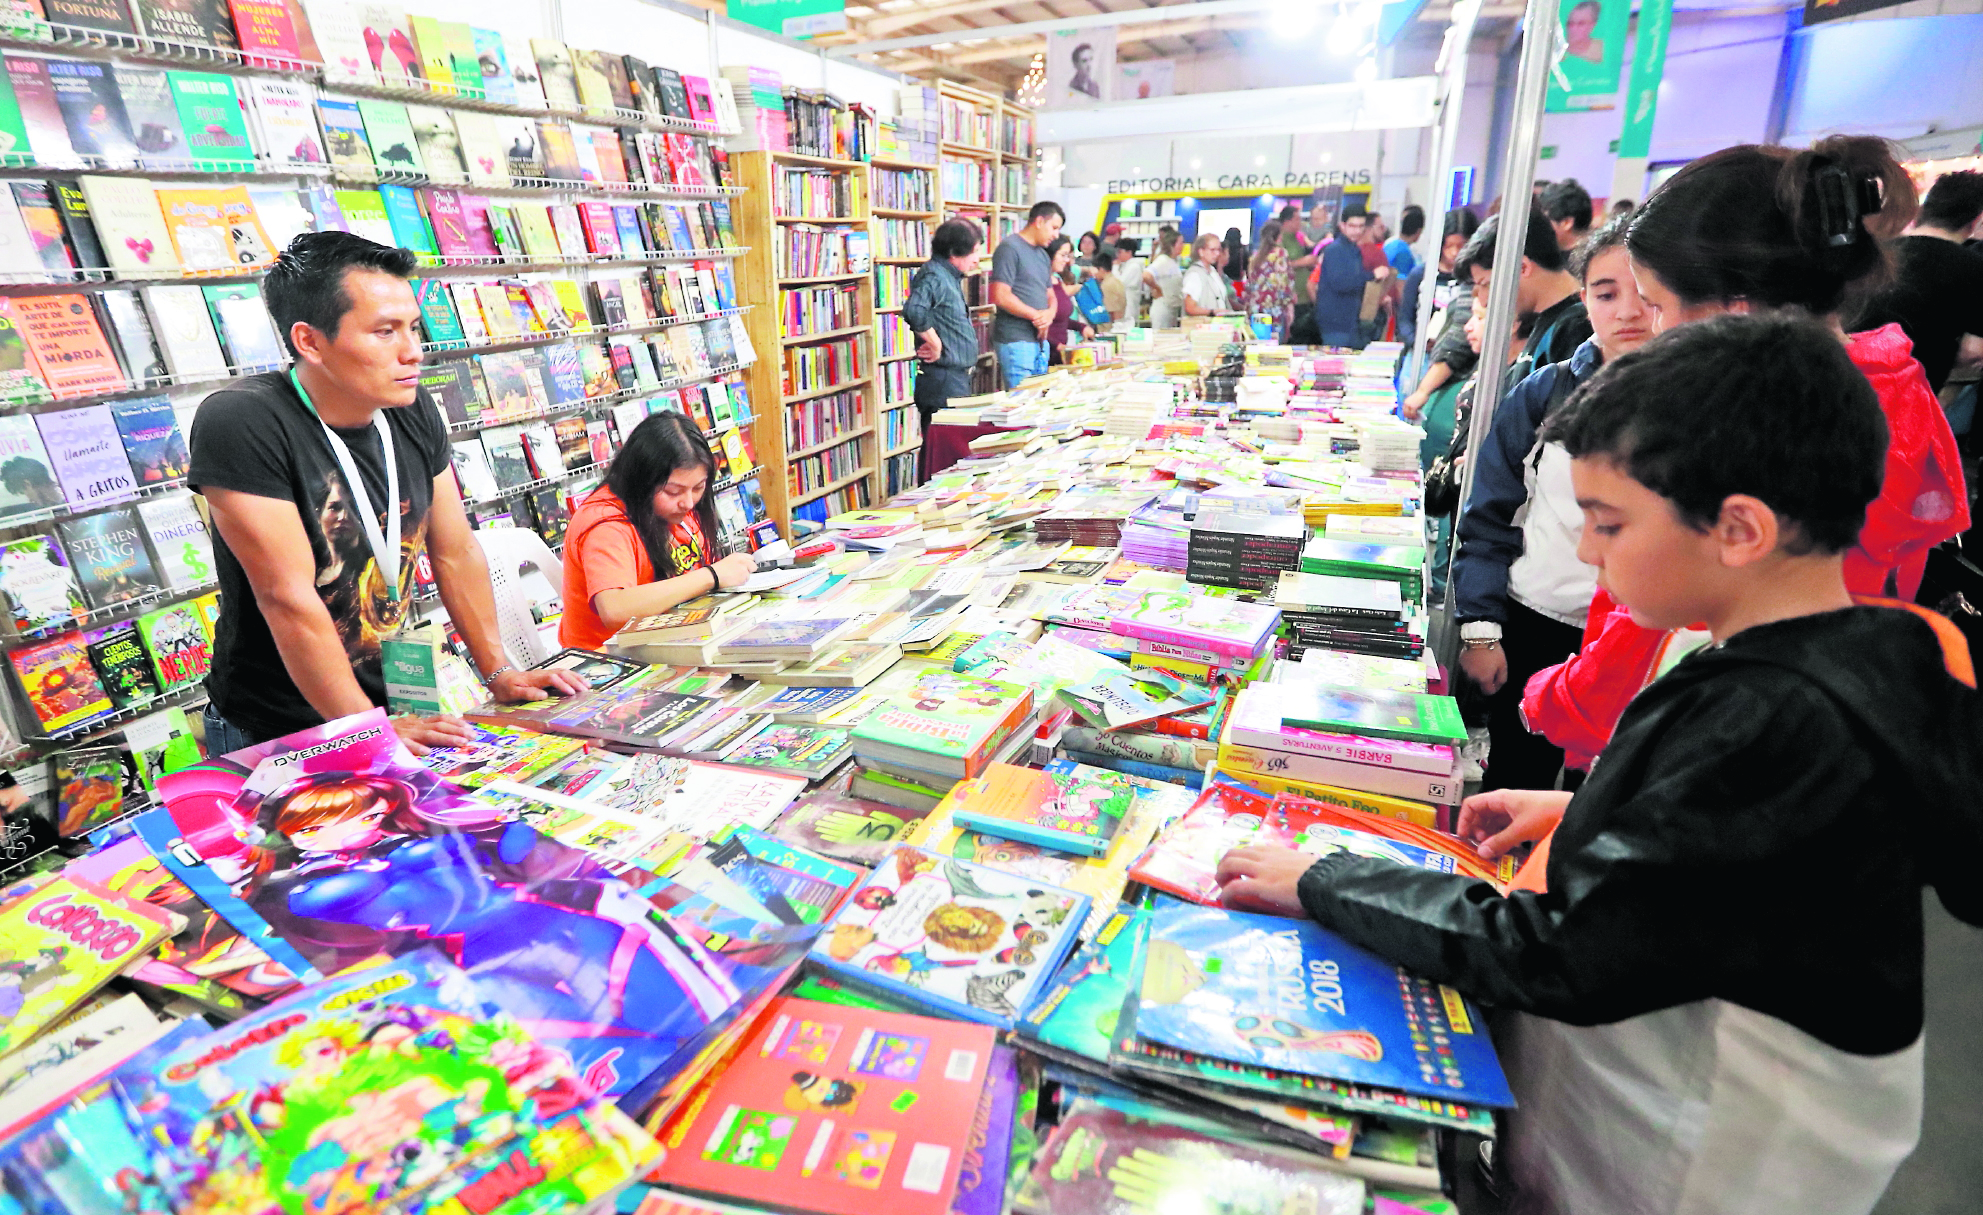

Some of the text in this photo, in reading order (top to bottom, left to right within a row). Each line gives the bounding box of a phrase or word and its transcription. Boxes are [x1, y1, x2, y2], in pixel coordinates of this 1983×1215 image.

[54, 3, 121, 20] FORTUNA
[152, 8, 198, 25] ISABEL
[237, 4, 285, 18] MUJERES
[151, 20, 206, 38] ALLENDE
[253, 16, 273, 26] DEL
[252, 26, 281, 36] ALMA
[1107, 168, 1372, 195] EDITORIAL CARA PARENS
[34, 302, 62, 310] SUTIL
[24, 311, 64, 321] ARTE DE
[29, 322, 50, 330] QUE
[34, 328, 90, 340] TE IMPORTE
[44, 348, 104, 364] MIRDA
[58, 375, 117, 388] MARK MANSON
[76, 474, 130, 501] A GRITOS
[154, 520, 206, 542] DINERO
[162, 518, 178, 528] QUE
[72, 528, 139, 552] STEPHEN
[86, 542, 136, 564] KING
[104, 640, 133, 657] CUENTOS
[1152, 644, 1170, 654] Biblia
[157, 644, 214, 685] NERDS
[877, 714, 968, 740] la Biblia
[886, 710, 971, 732] preescolar
[273, 727, 383, 768] OVERWATCH
[1112, 734, 1154, 760] Cuentos
[1282, 738, 1334, 752] AVENTURAS
[1266, 756, 1291, 772] 365
[1345, 748, 1393, 764] BARBIE
[730, 780, 784, 826] KARMA
[1301, 790, 1350, 809] Patito
[1350, 800, 1380, 815] Feo
[26, 894, 142, 960] CONDORITO
[1273, 930, 1308, 1012] RUSSIA
[1308, 960, 1346, 1016] 2018
